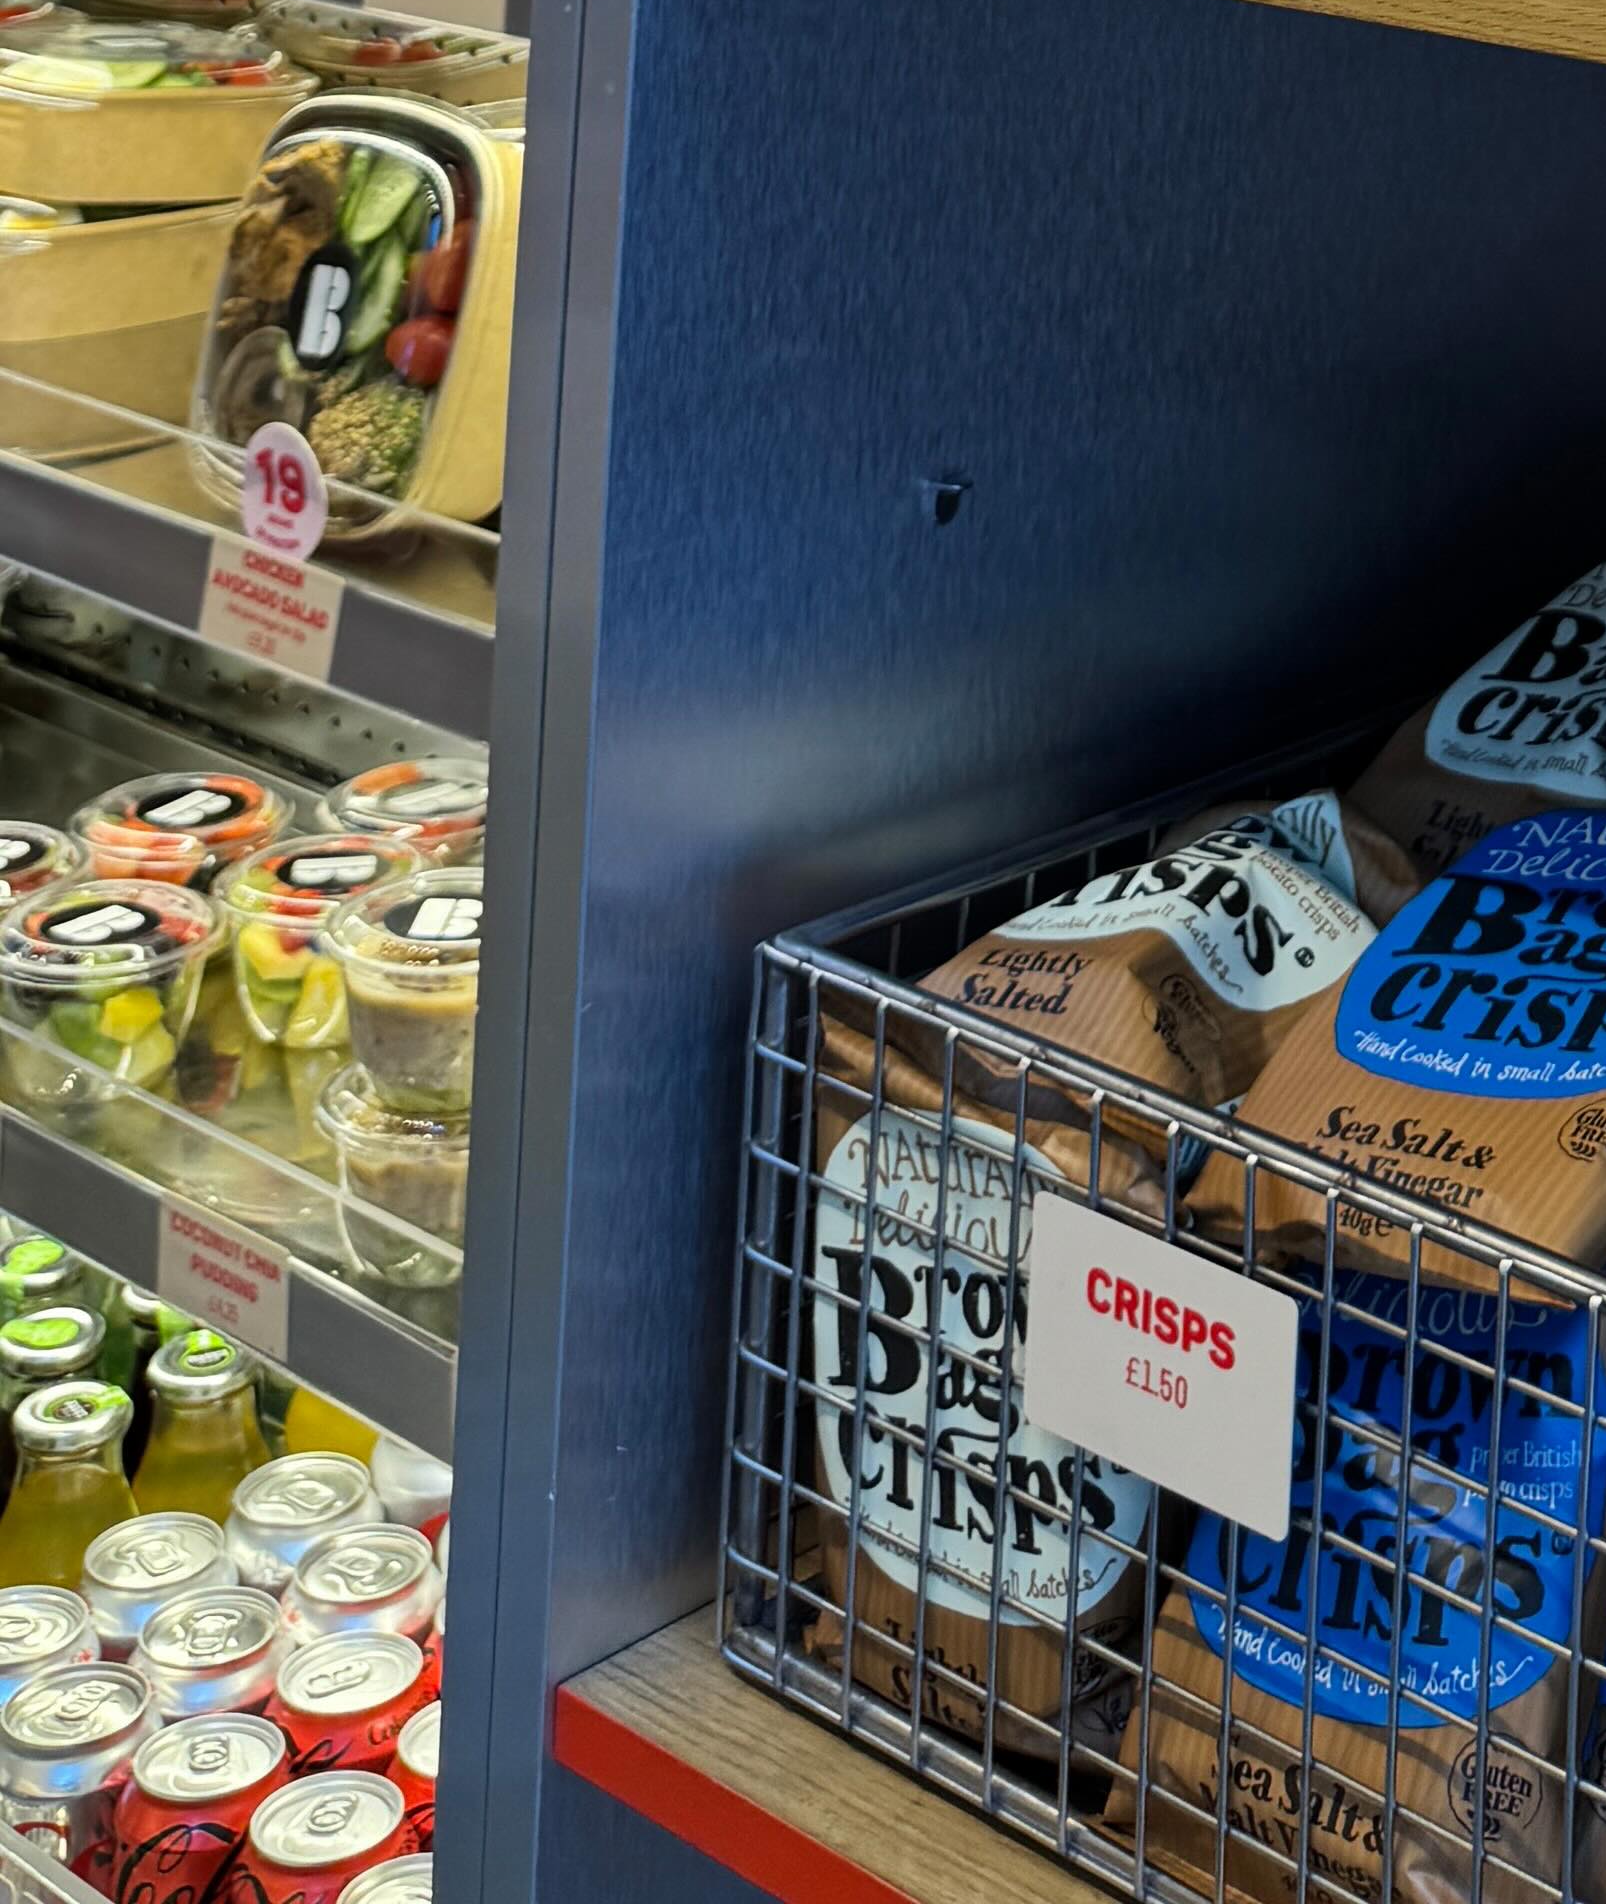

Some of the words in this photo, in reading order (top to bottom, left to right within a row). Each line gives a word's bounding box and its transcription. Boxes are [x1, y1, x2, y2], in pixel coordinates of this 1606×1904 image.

[298, 264, 352, 360] B
[255, 447, 306, 514] 19
[978, 948, 1093, 979] Lightly
[953, 973, 1073, 1016] Salted
[1472, 1056, 1491, 1079] in
[1498, 1062, 1556, 1083] small
[1316, 1105, 1381, 1145] Sea
[1381, 1117, 1467, 1162] Salt
[1462, 1142, 1497, 1169] &
[1085, 1267, 1236, 1370] CRISPS
[1124, 1356, 1189, 1410] £1.50
[1268, 1640, 1331, 1688] Cooed
